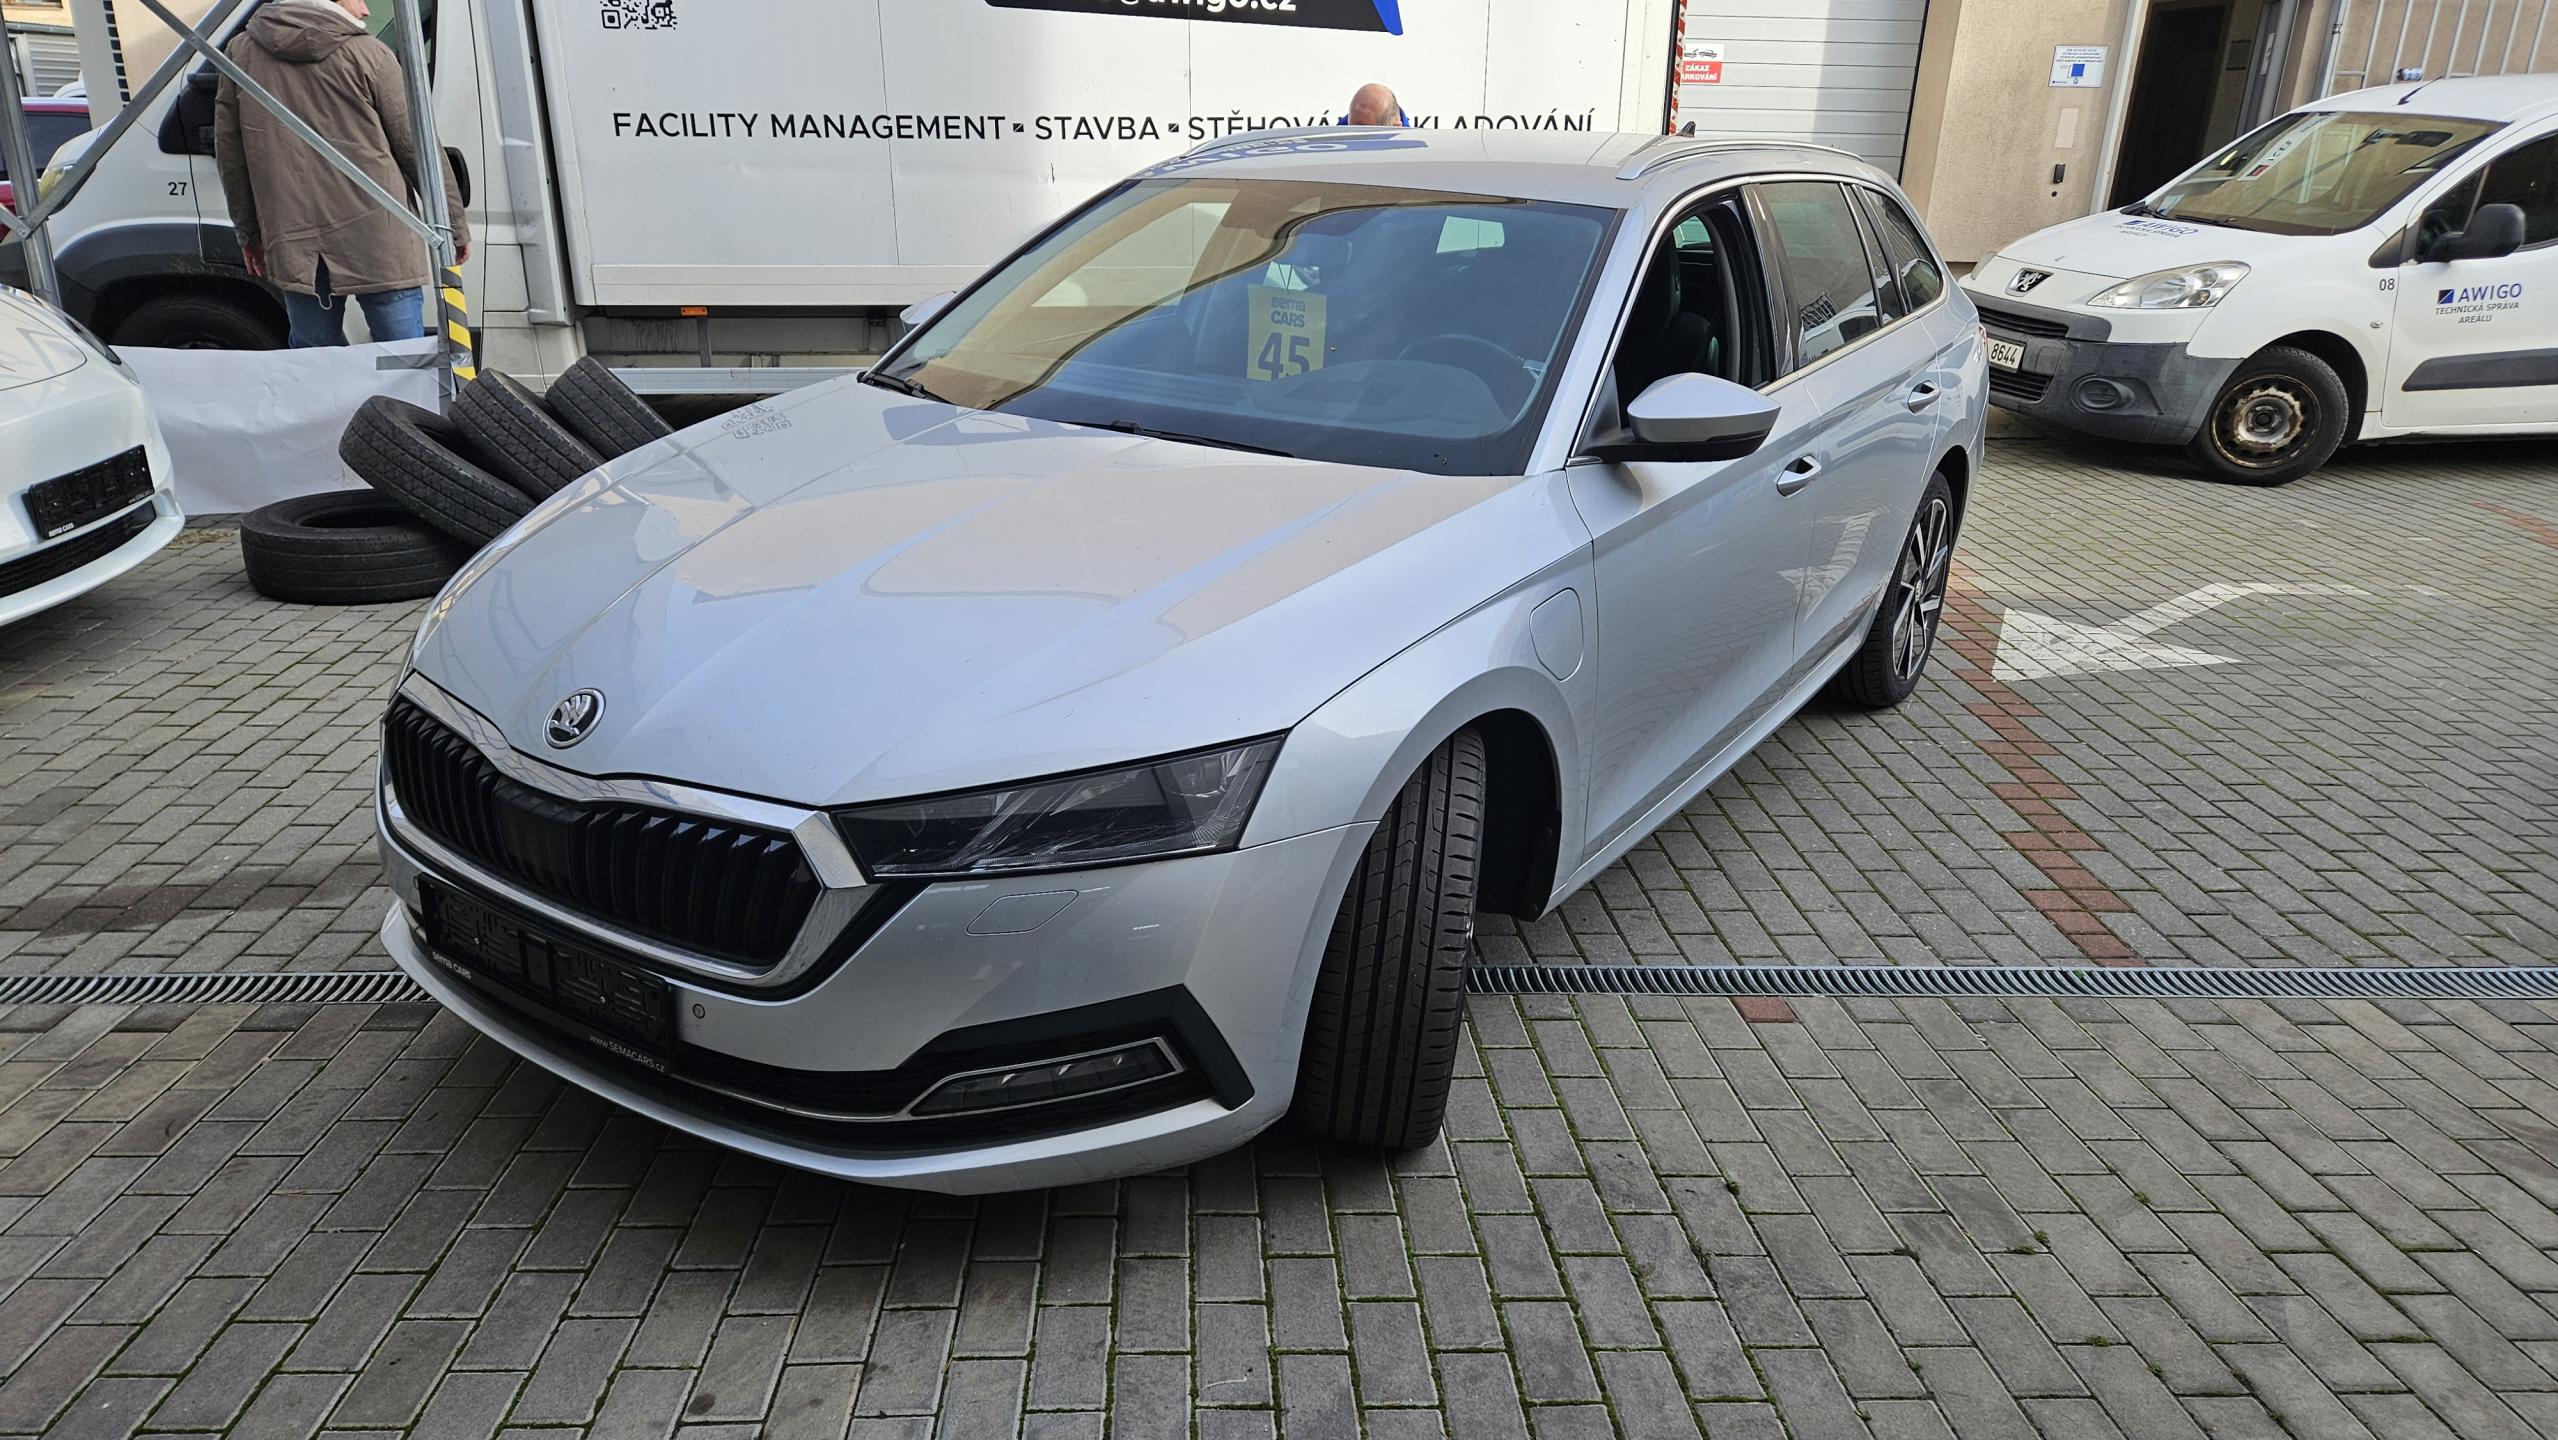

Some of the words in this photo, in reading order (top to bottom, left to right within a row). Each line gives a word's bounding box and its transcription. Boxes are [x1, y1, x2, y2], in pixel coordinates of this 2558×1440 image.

[612, 112, 759, 138] FACILITY
[770, 114, 1006, 140] MANAGEMENT
[1034, 116, 1160, 140] STAVBA
[168, 181, 187, 196] 27
[2379, 278, 2395, 291] 08
[2458, 283, 2522, 303] AWIGO
[2435, 303, 2484, 315] TECHNICKÁ
[2486, 301, 2519, 312] SPRÁVA
[1270, 310, 1305, 328] CARS
[2458, 313, 2492, 324] AREÁLU
[1257, 331, 1310, 380] 45
[1991, 343, 2018, 365] 8644
